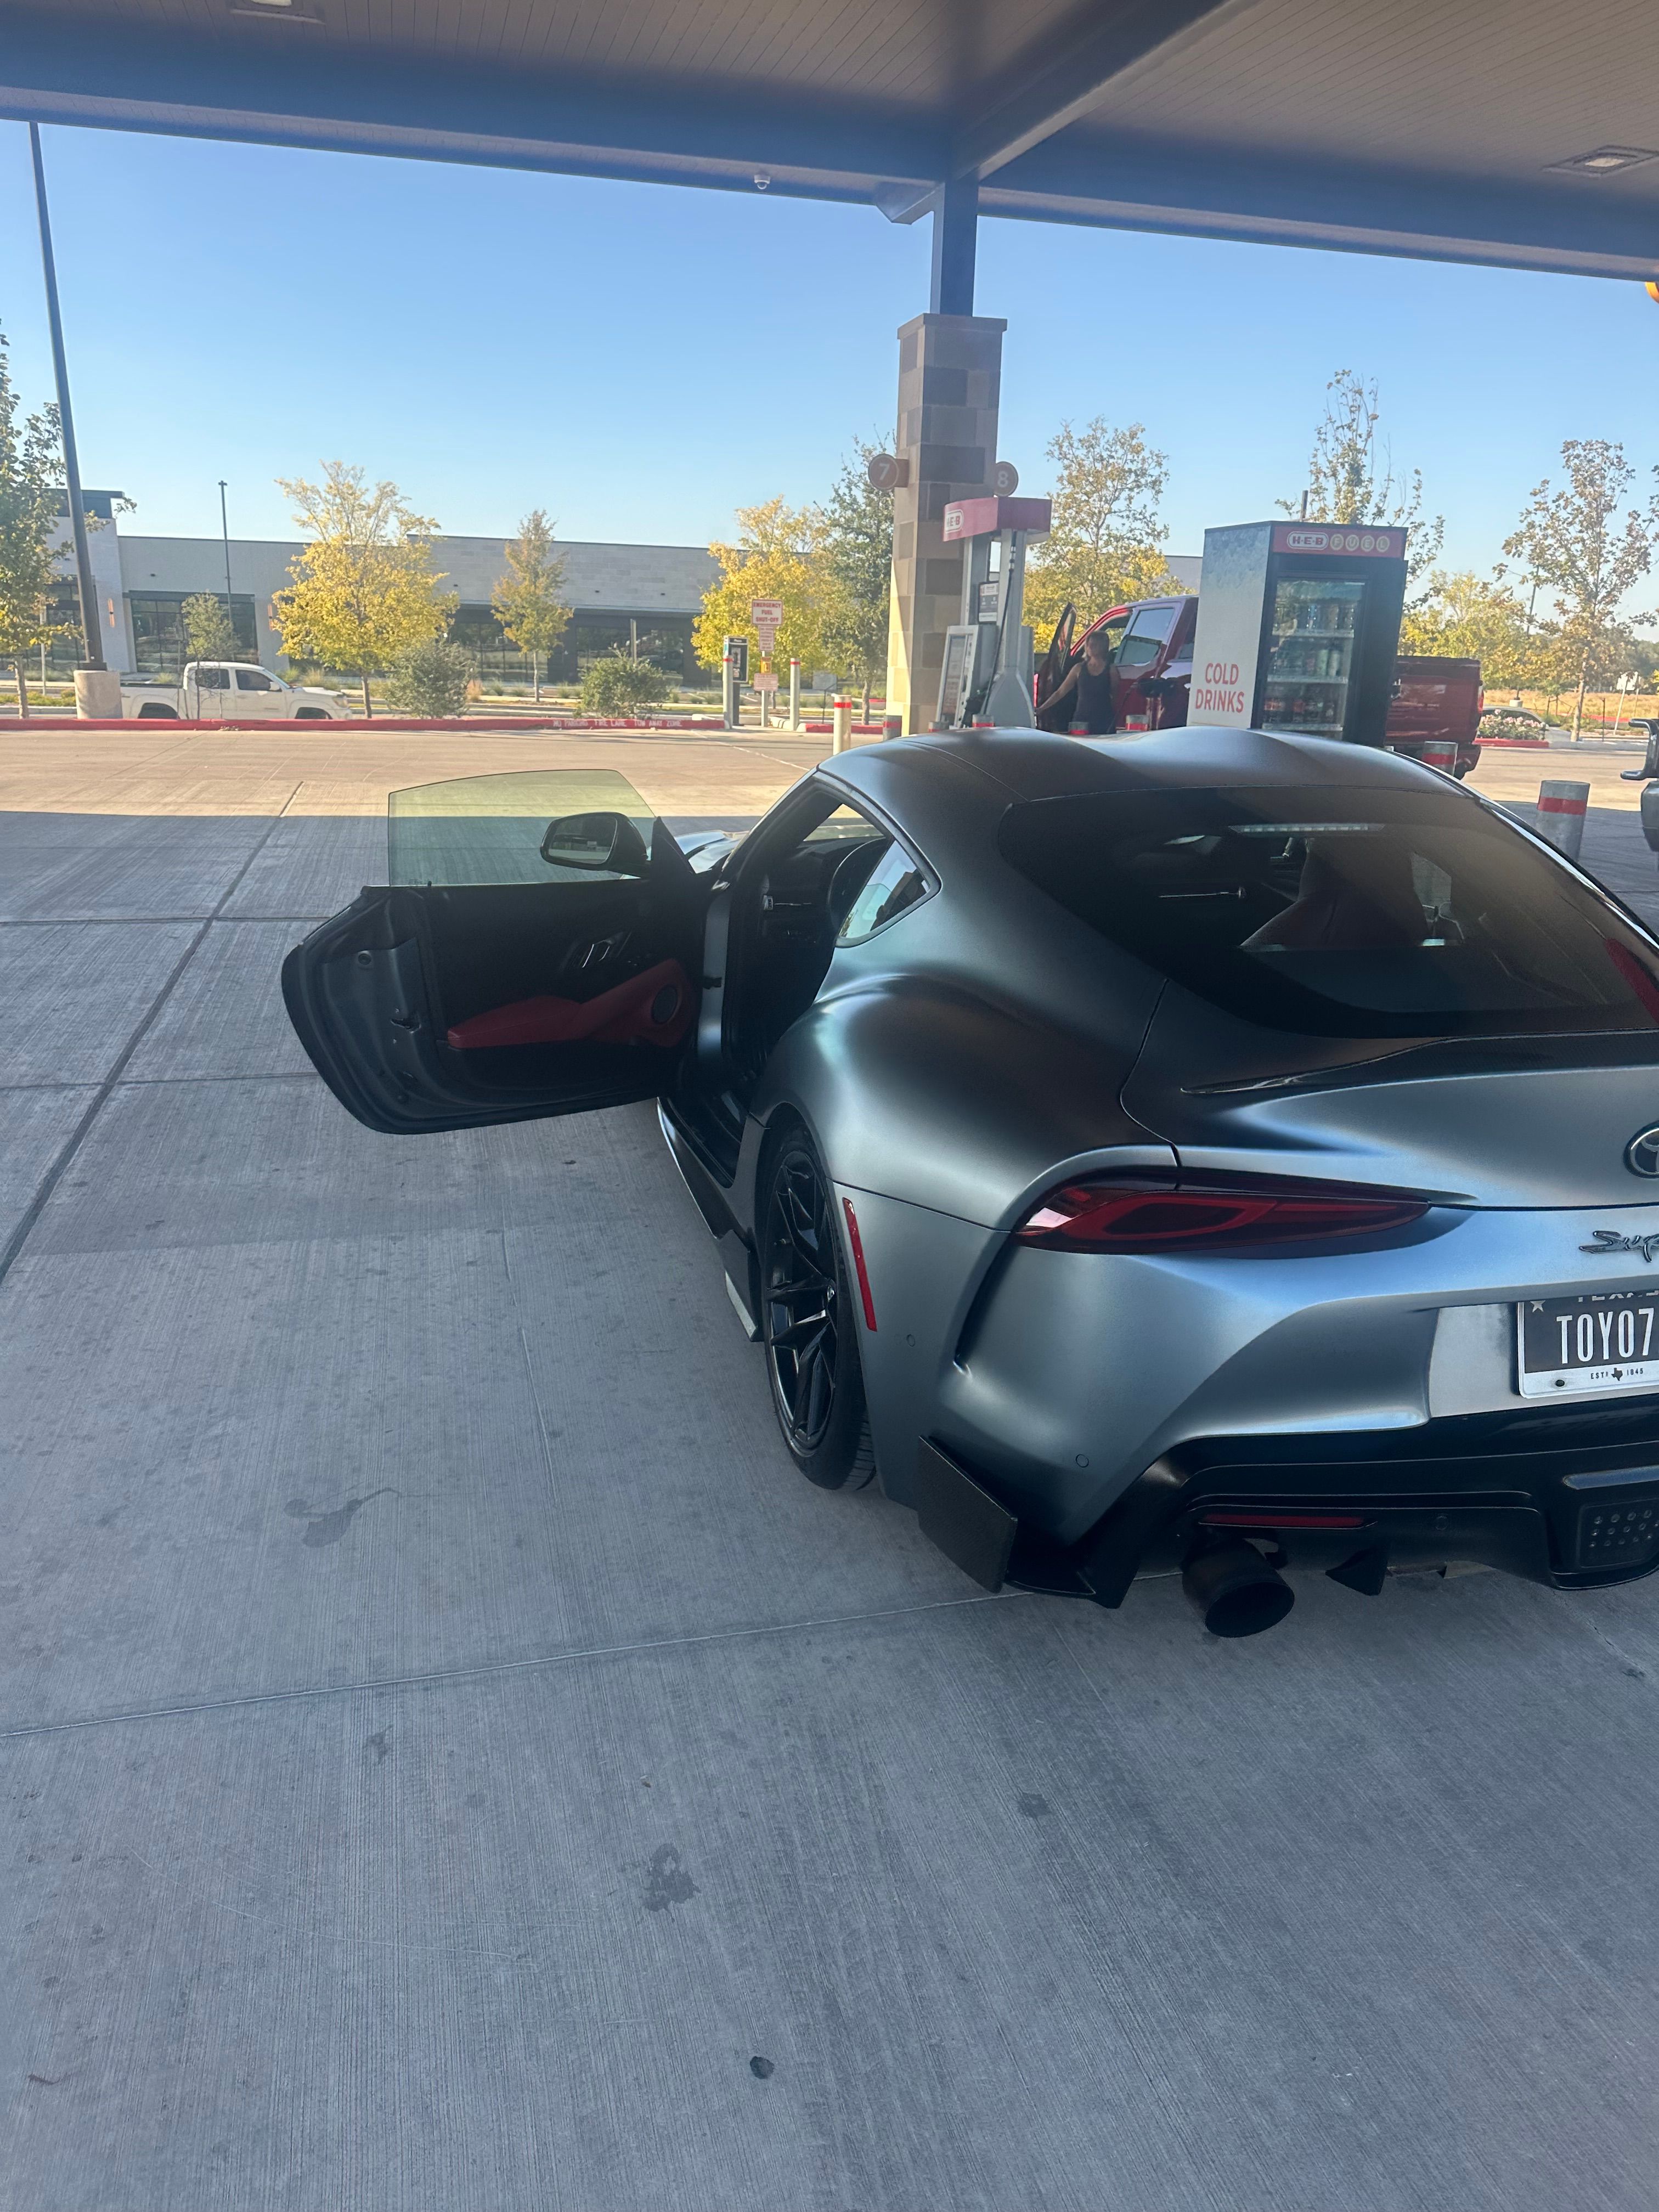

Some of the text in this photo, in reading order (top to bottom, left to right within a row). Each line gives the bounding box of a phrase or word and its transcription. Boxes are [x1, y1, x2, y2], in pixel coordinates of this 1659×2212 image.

[879, 463, 890, 481] 7
[997, 470, 1008, 488] 8
[1333, 537, 1387, 549] FUEL
[1205, 662, 1239, 685] COLD
[1195, 689, 1244, 713] DRINKS
[1627, 1368, 1644, 1376] 1845
